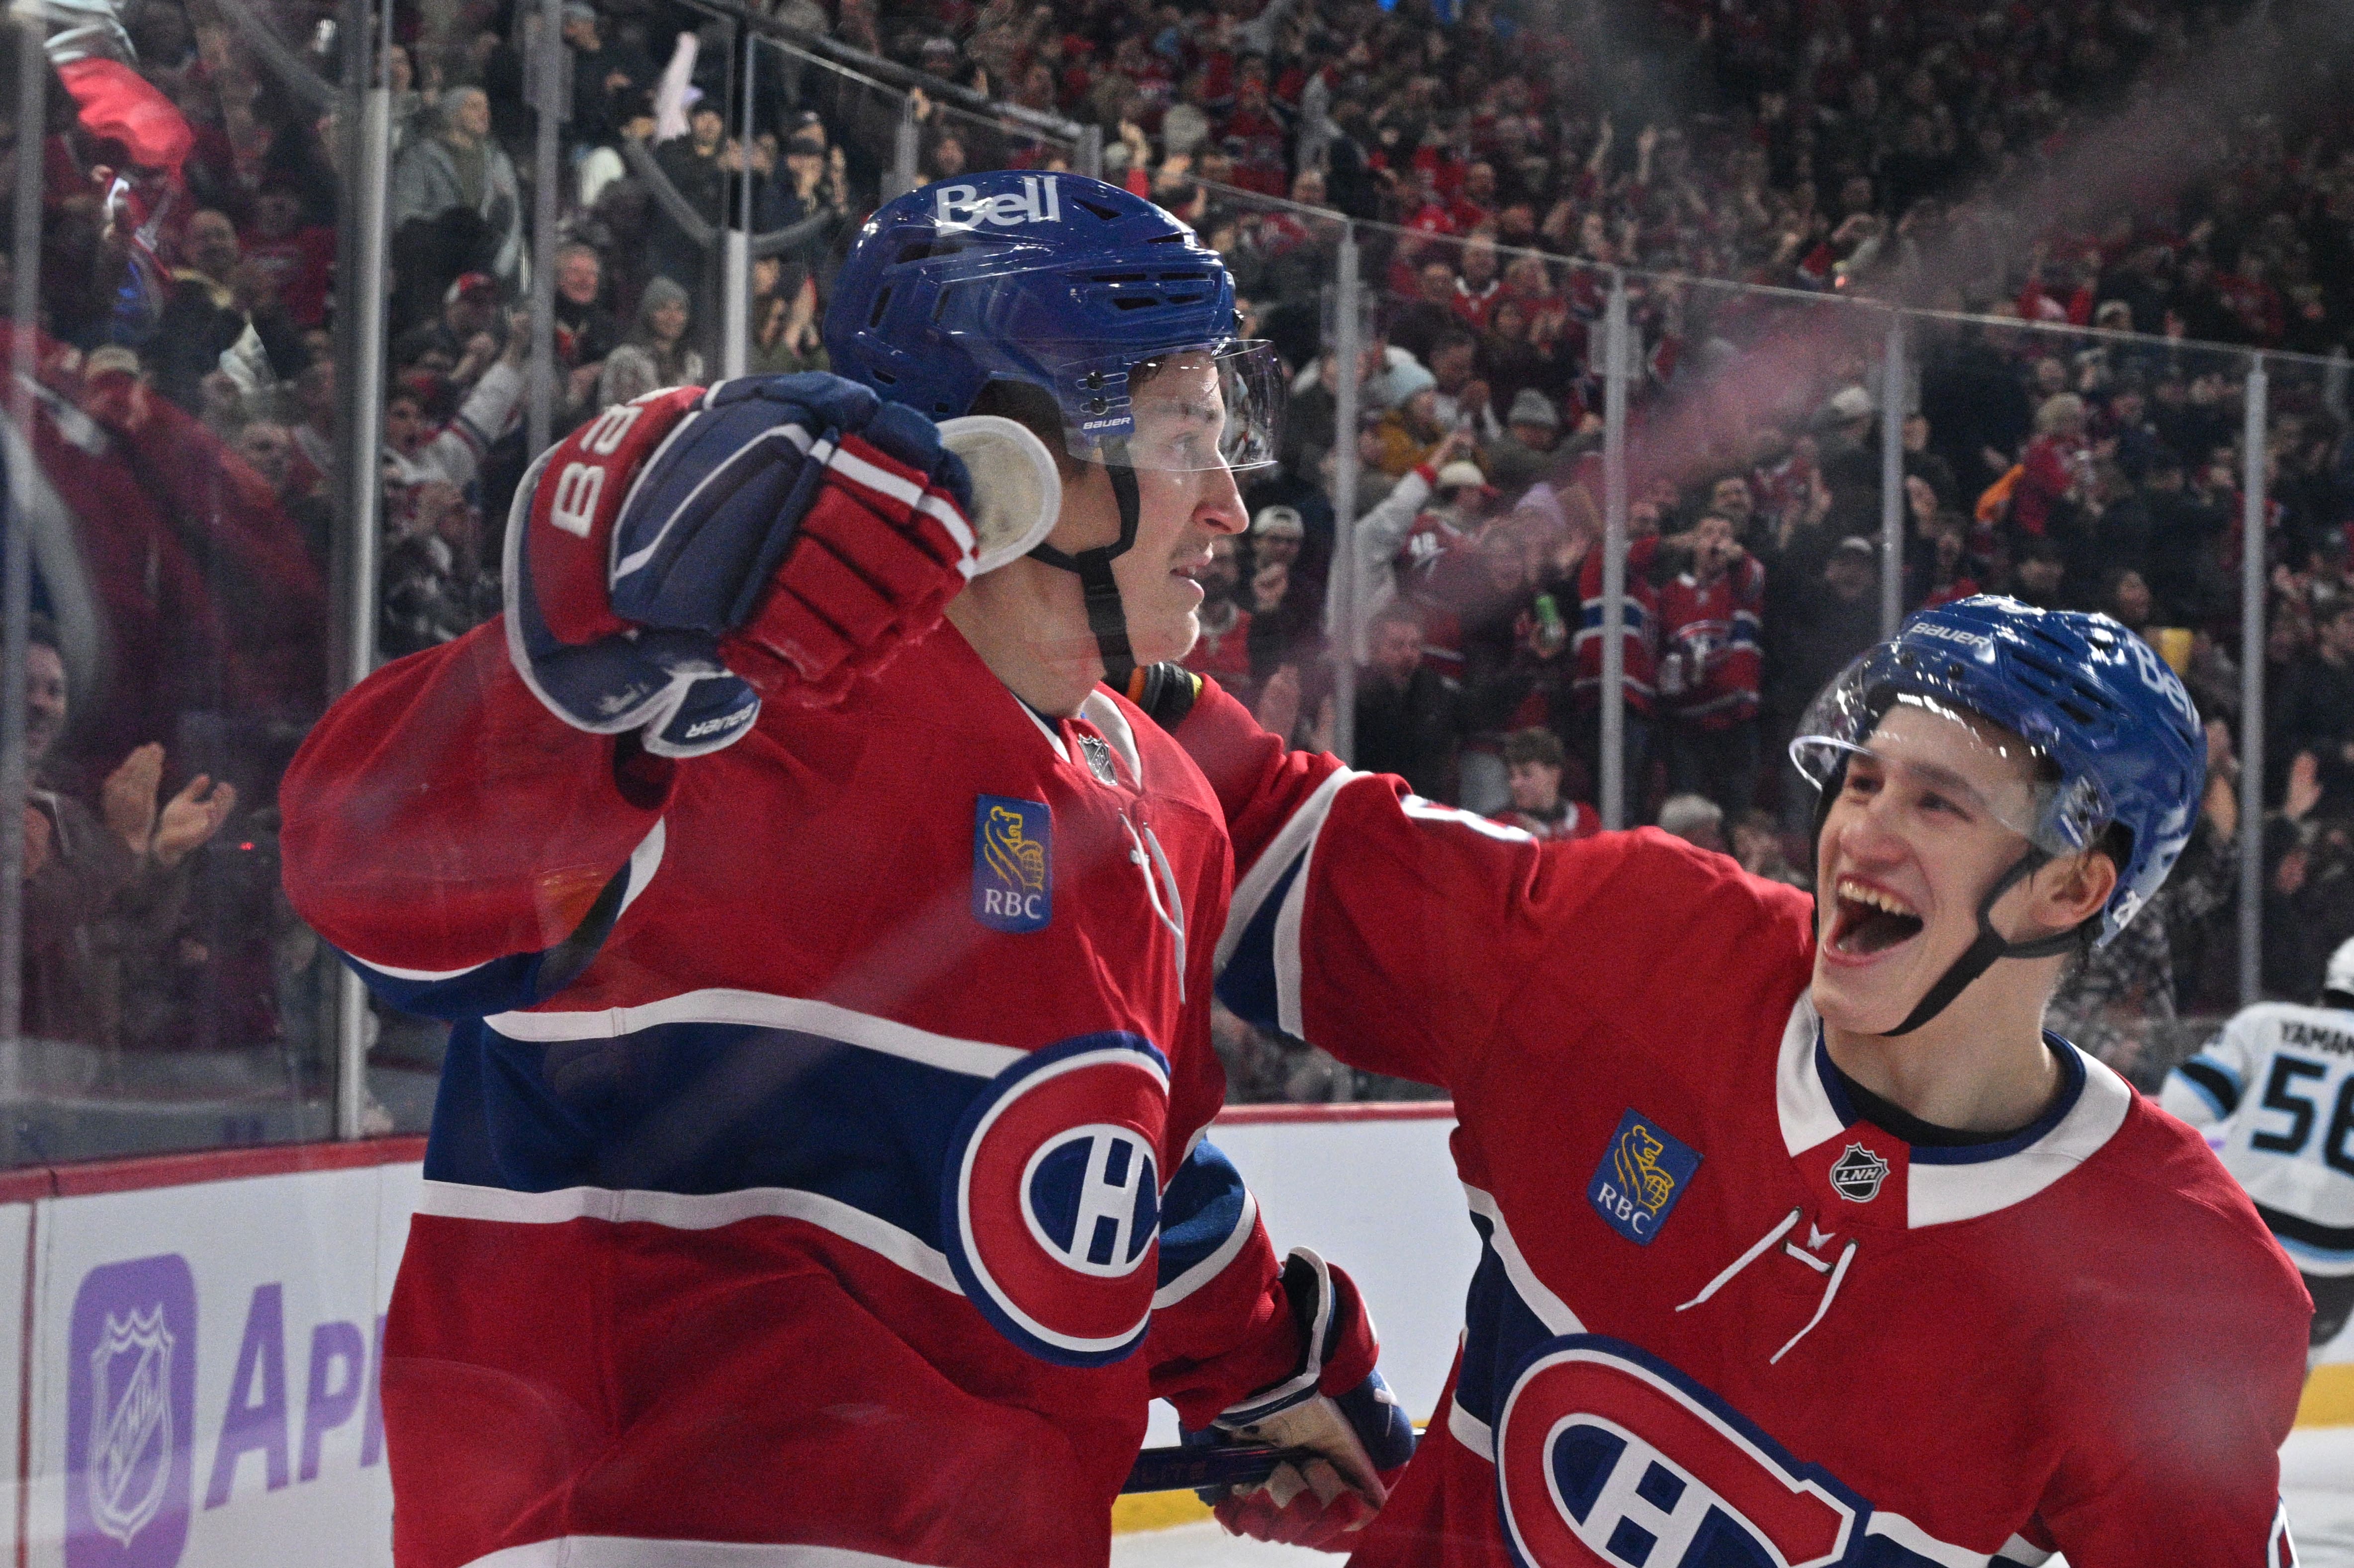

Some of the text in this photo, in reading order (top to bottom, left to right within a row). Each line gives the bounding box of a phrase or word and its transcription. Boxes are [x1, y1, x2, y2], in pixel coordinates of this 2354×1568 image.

[936, 175, 1062, 238] Bell
[984, 887, 1041, 919] RBC
[1838, 1167, 1880, 1182] LNH
[1597, 1181, 1652, 1235] RBC
